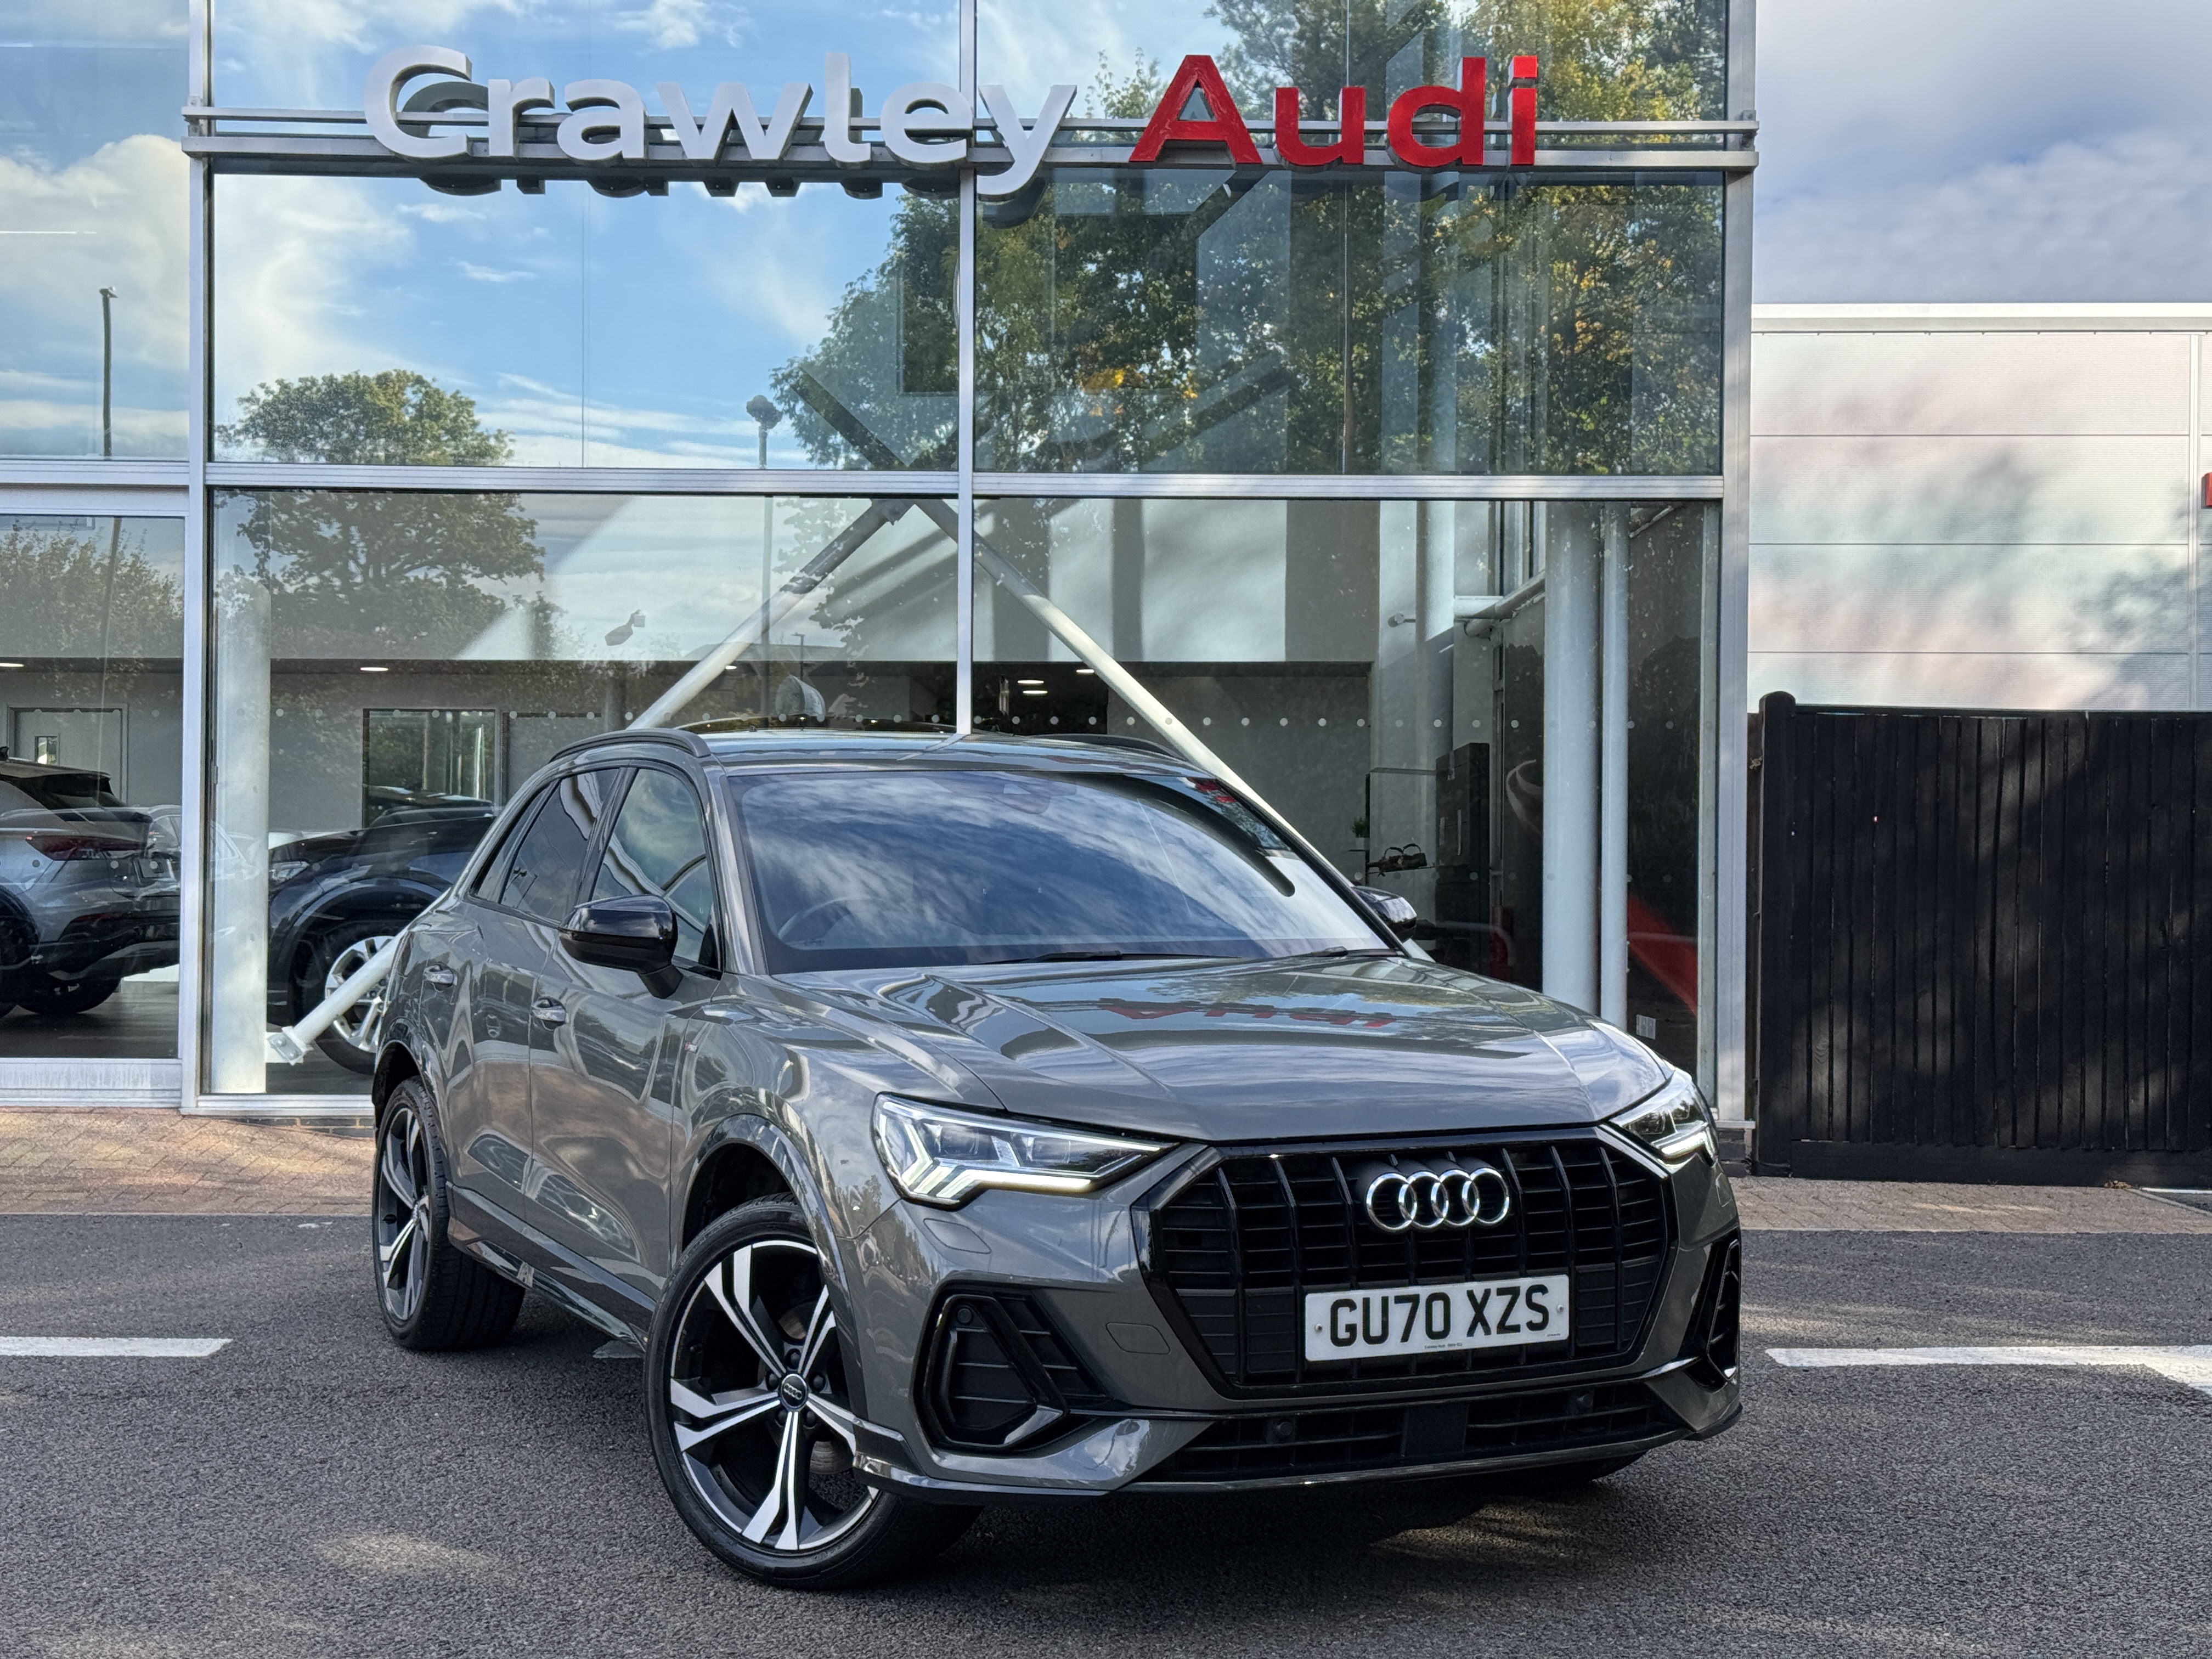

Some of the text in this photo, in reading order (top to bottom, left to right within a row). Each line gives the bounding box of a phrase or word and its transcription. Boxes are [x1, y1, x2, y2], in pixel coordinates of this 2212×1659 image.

[363, 45, 1538, 200] Crawley Audi
[1330, 1284, 1549, 1347] GU70 XZS
